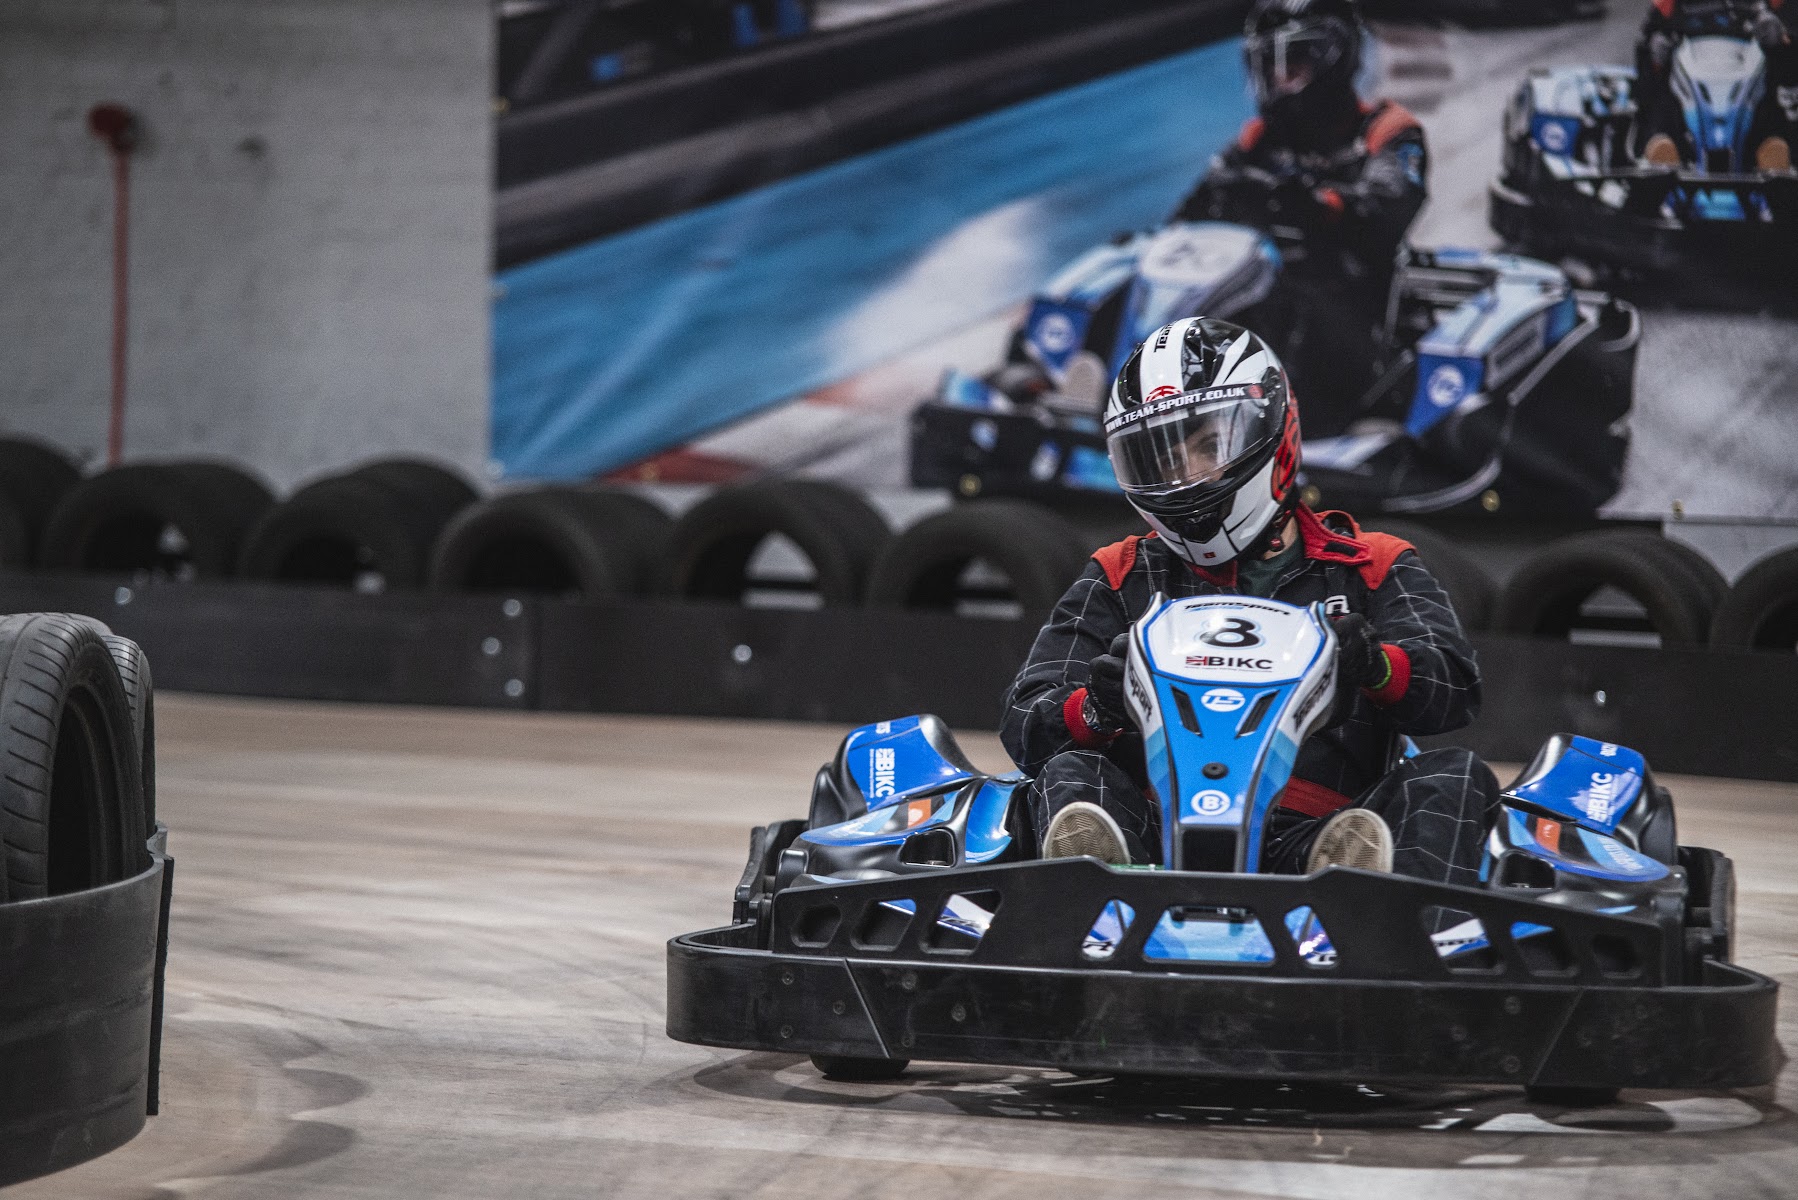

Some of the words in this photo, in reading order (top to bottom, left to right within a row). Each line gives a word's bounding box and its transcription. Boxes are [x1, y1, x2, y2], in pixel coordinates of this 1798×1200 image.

[1200, 617, 1260, 648] 8
[1207, 655, 1273, 670] BIKC
[875, 757, 896, 798] BIKC
[1588, 772, 1613, 810] BIKC
